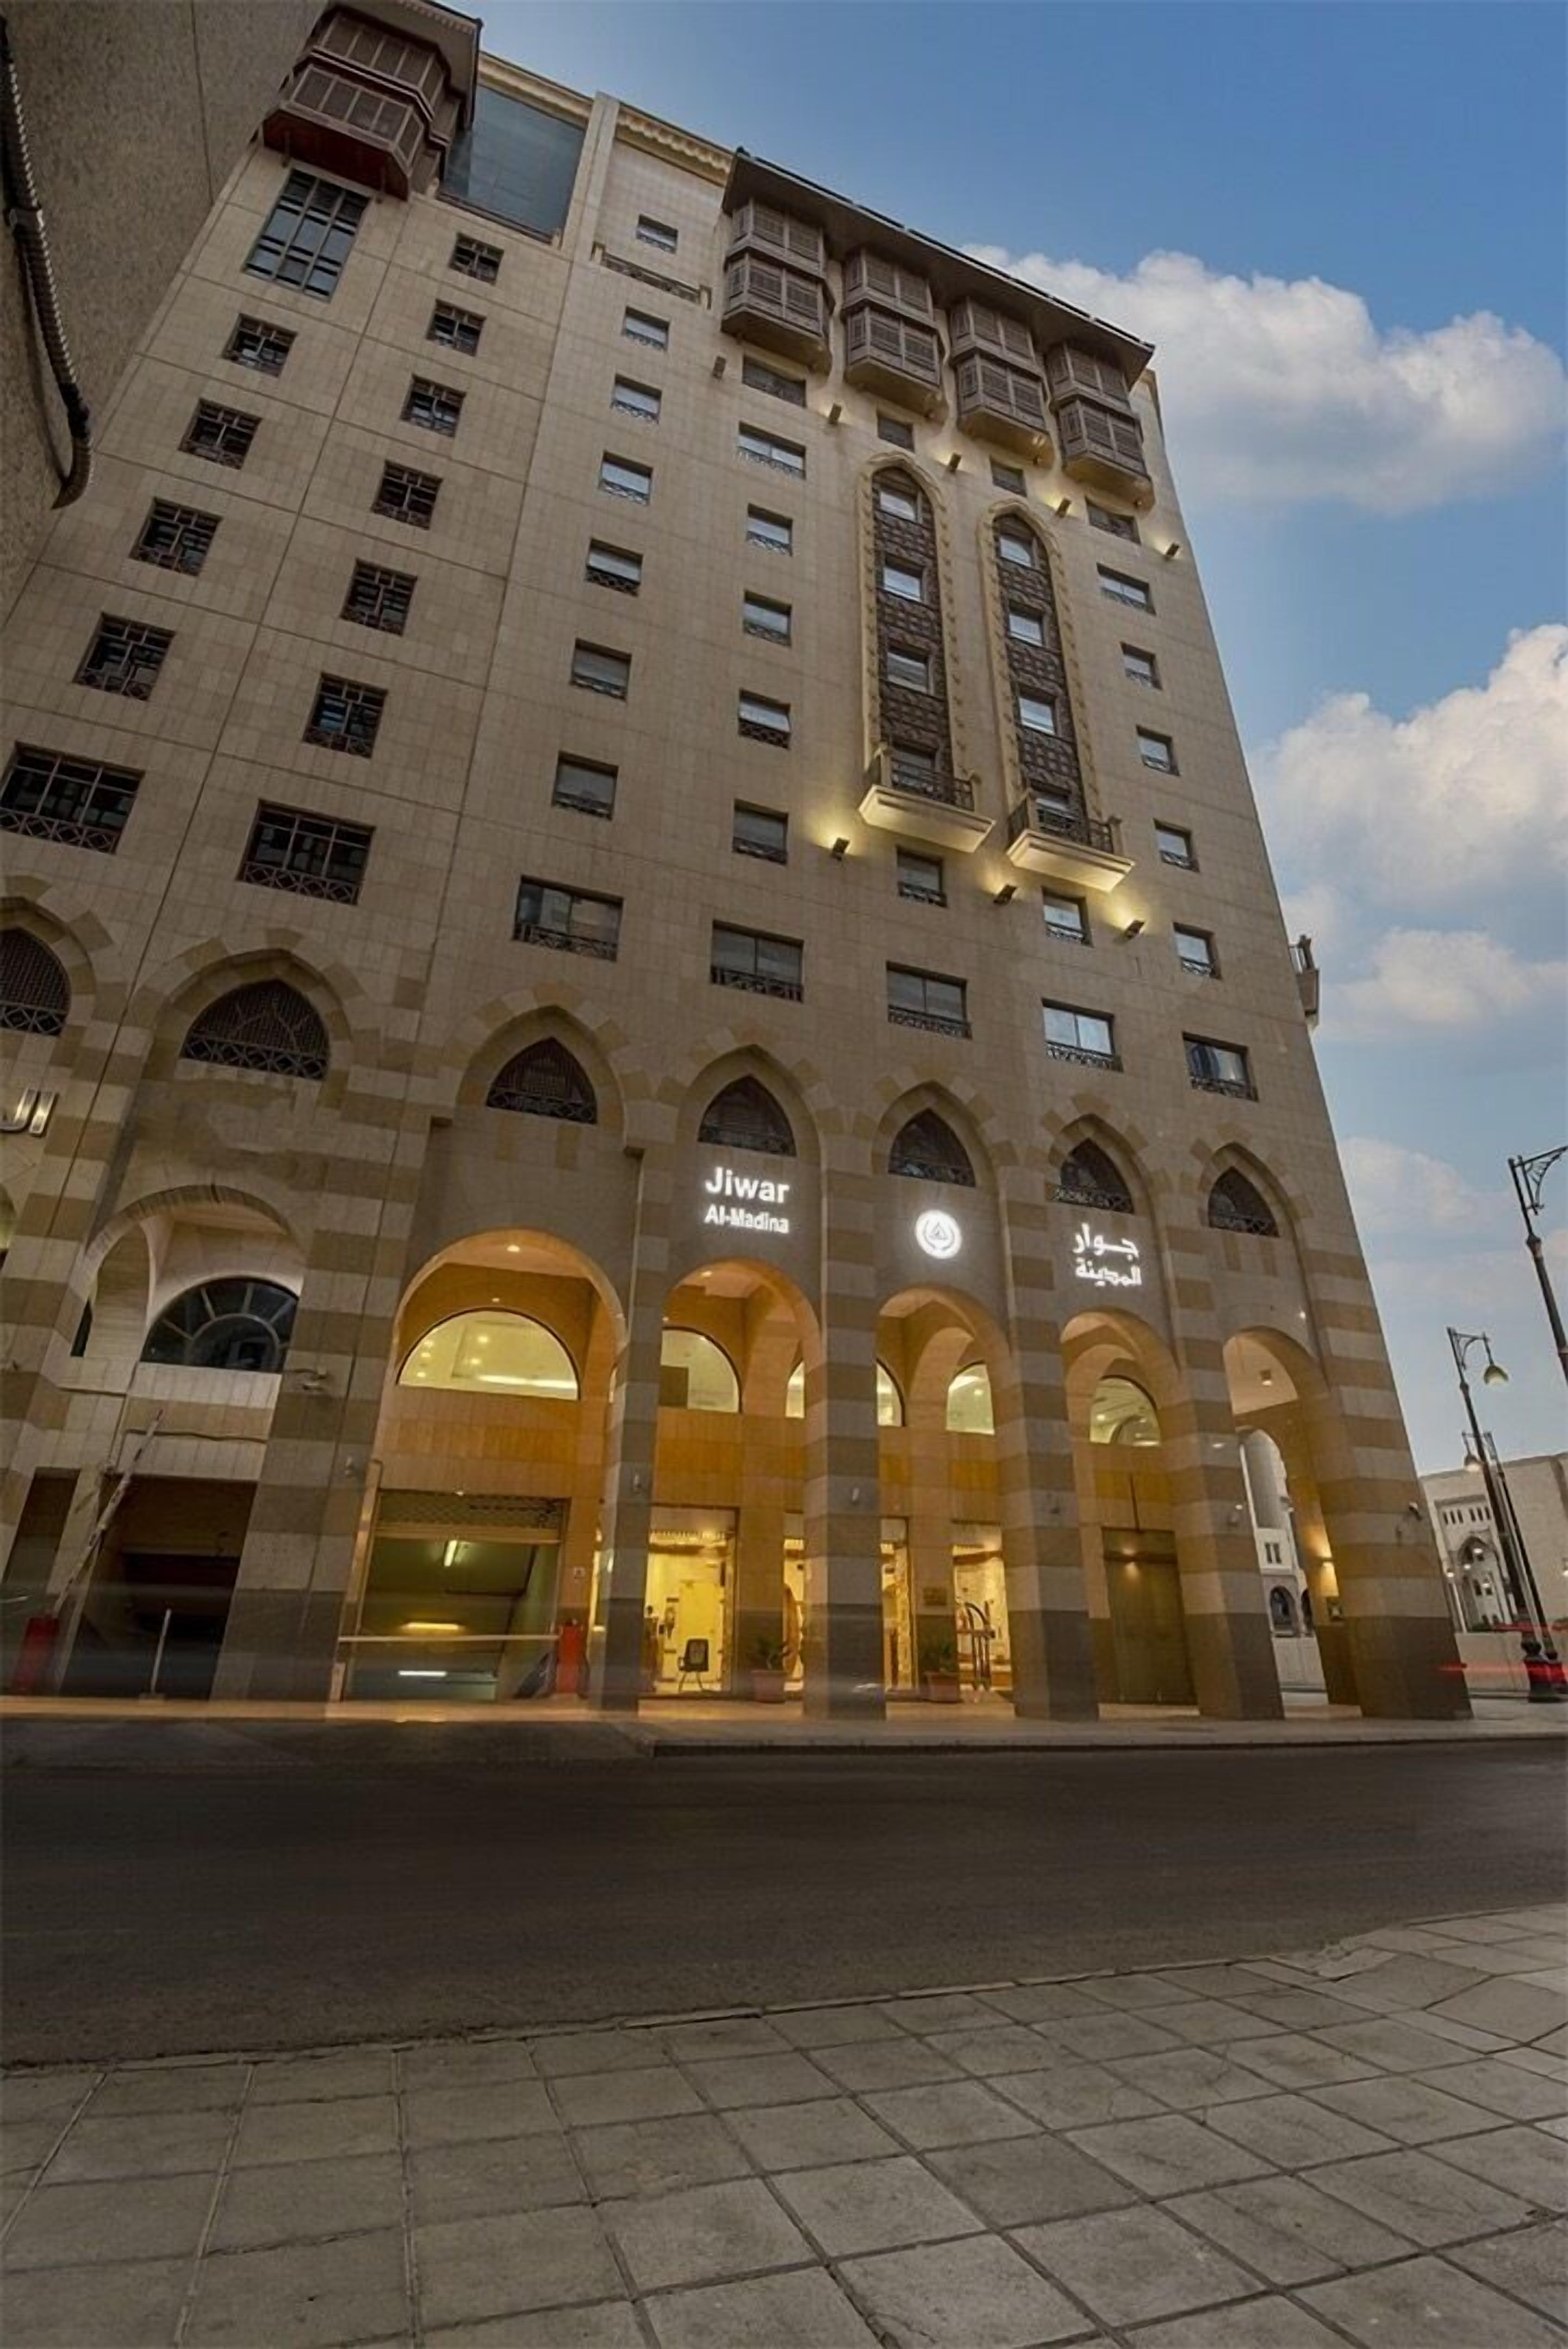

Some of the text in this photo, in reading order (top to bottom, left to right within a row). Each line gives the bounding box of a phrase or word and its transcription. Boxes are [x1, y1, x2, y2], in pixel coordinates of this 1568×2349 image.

[705, 1166, 789, 1203] Jiwar
[704, 1203, 789, 1234] Al-Madina
[1073, 1222, 1139, 1261] جوار
[1075, 1257, 1142, 1287] المدينة
